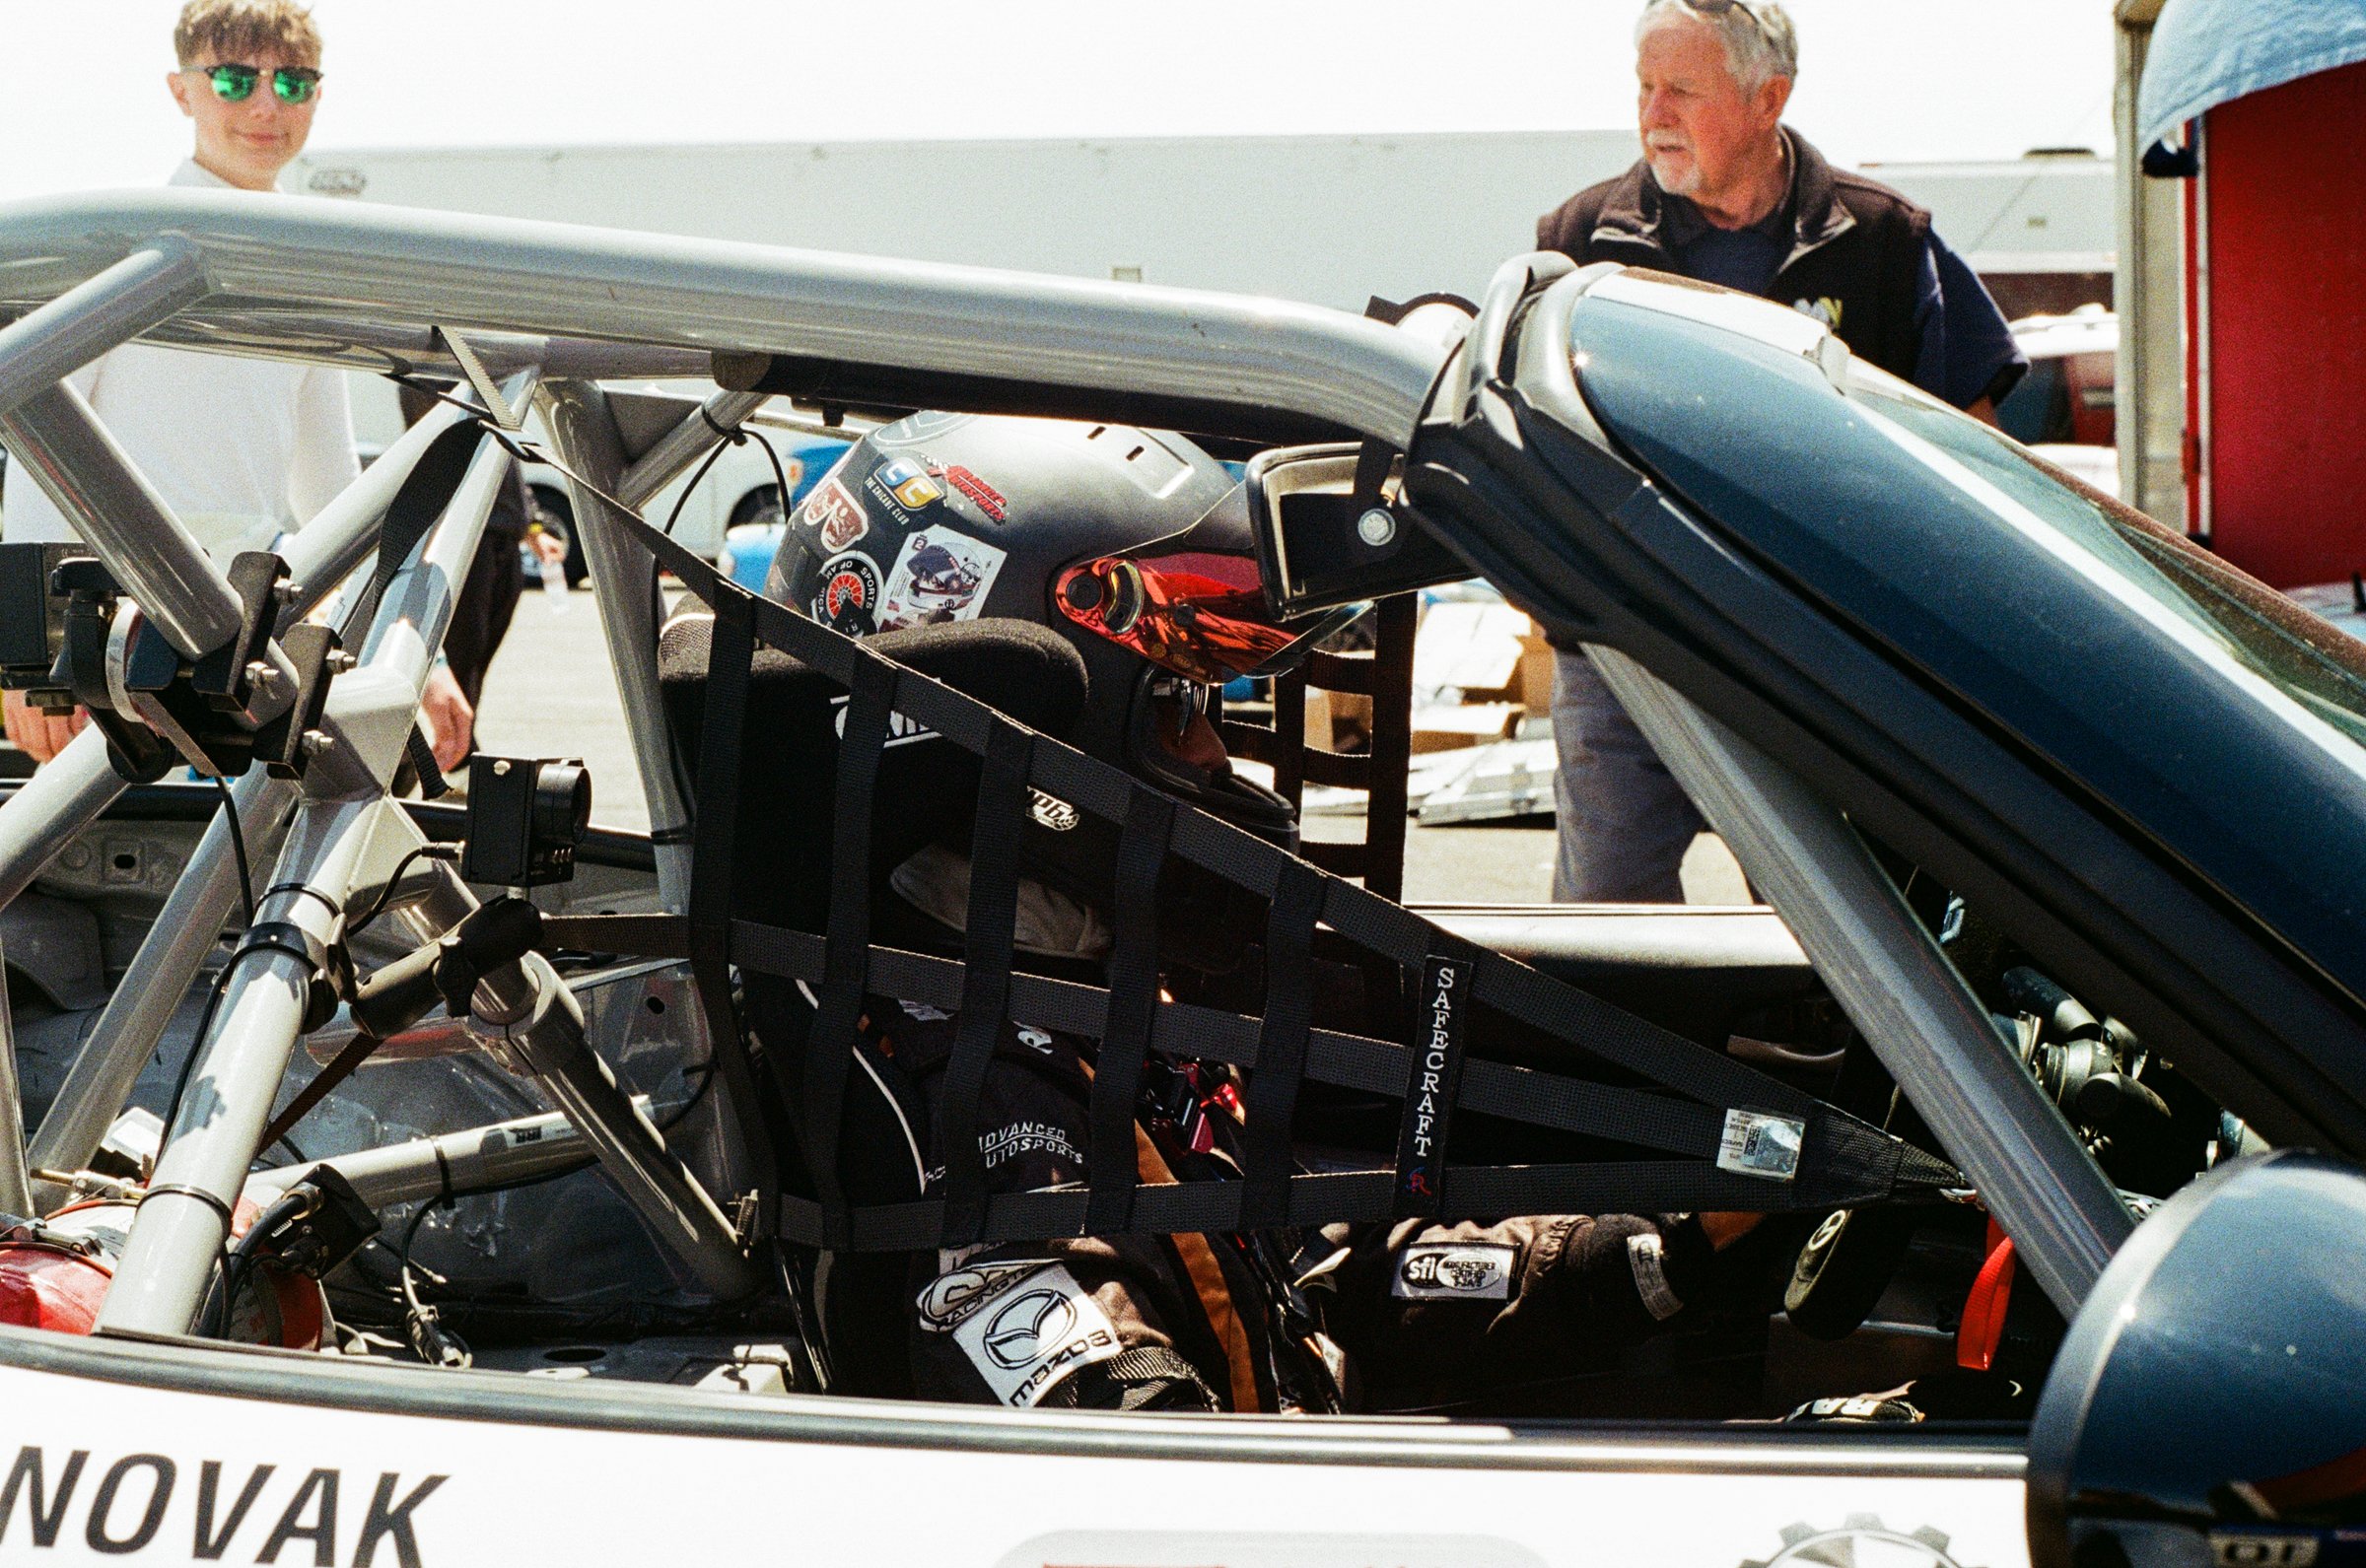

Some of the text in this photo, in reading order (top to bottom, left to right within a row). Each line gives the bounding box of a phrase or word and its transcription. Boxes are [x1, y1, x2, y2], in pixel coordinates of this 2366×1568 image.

[860, 567, 876, 609] SPORTS
[1415, 967, 1455, 1157] SAFECRAFT
[978, 1122, 1066, 1153] DVANCED
[985, 1137, 1083, 1169] UTOSPORTS
[939, 1279, 1009, 1327] RACING
[0, 1445, 452, 1568] NOVAK
